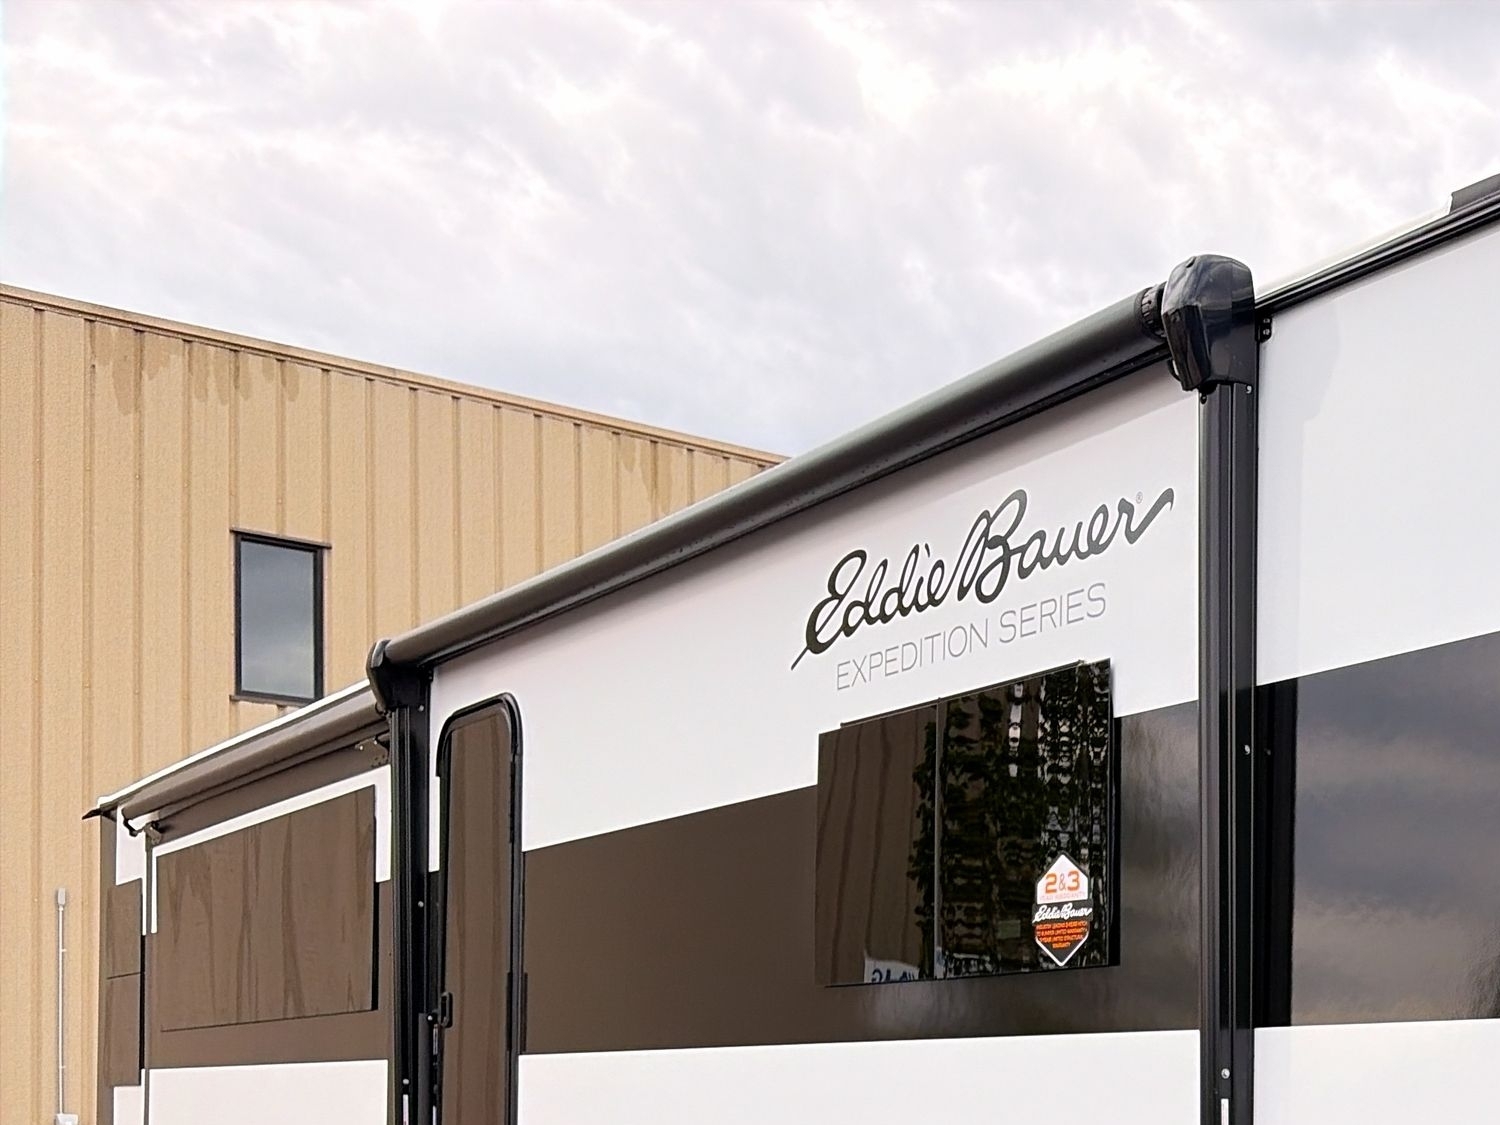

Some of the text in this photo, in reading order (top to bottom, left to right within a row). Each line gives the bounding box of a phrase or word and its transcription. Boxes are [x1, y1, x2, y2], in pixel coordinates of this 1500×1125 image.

[791, 488, 1175, 670] Eddie Bauer
[836, 582, 1107, 691] EXPEDITION SERIES
